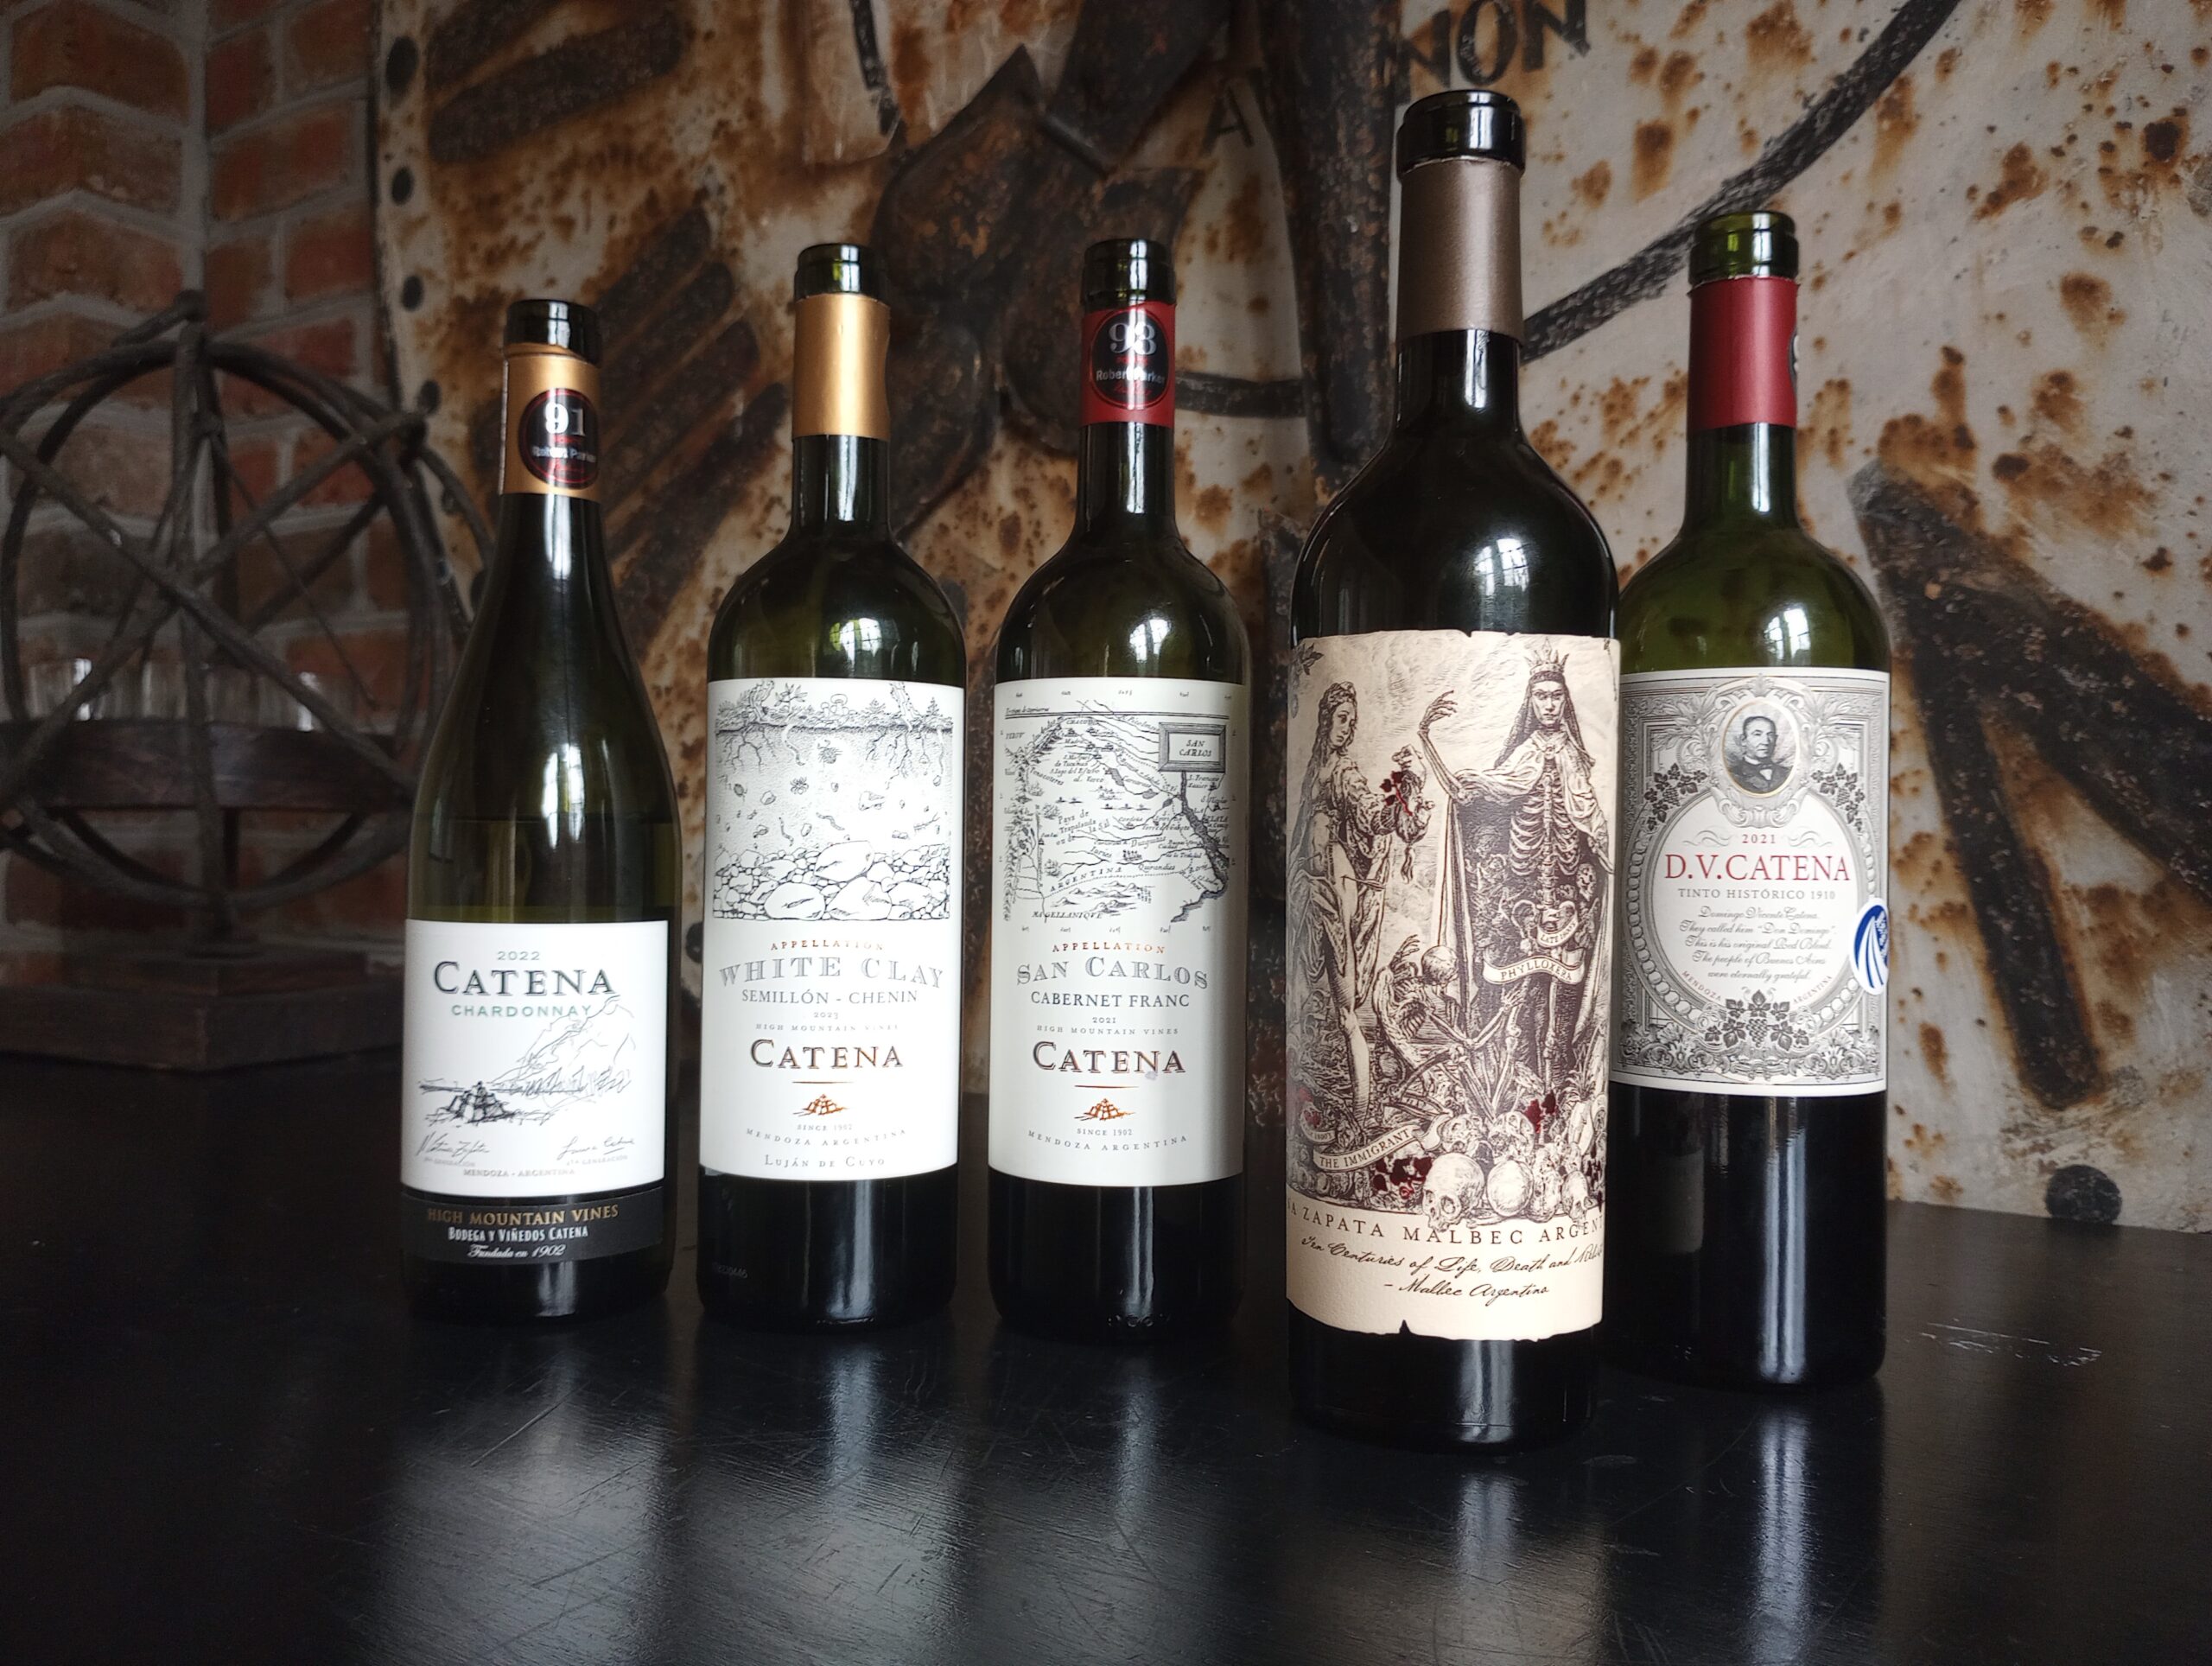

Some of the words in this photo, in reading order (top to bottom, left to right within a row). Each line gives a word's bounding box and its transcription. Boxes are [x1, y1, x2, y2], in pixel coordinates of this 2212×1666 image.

[1096, 366, 1132, 381] Rober
[544, 400, 586, 436] 91
[1741, 833, 1777, 844] 2021
[1678, 888, 1720, 899] TINTO
[1726, 887, 1805, 900] HISTÓRICO
[1811, 891, 1836, 900] 1910
[1707, 922, 1732, 933] called
[1735, 923, 1754, 933] him
[770, 939, 884, 951] APPELLATION
[1052, 941, 1166, 954] APPELLATION
[1685, 934, 1707, 948] This
[1718, 938, 1731, 948] his
[1732, 938, 1771, 952] original
[497, 951, 540, 961] 2022
[1692, 950, 1713, 963] The
[1711, 953, 1742, 966] people
[1744, 953, 1756, 967] of
[1755, 951, 1794, 965] Buenos
[434, 961, 616, 996] CATENA
[719, 957, 842, 988] WHITE
[861, 957, 944, 989] CLAY
[1016, 960, 1070, 986] SAN
[1084, 956, 1209, 989] CARLOS
[1501, 959, 1573, 981] PHYLLOXERA
[1681, 970, 1722, 1002] MENDOZA
[1793, 975, 1833, 1004] ARGENTINA
[741, 989, 830, 1004] SEMILLÓN
[849, 990, 918, 1004] CHENIN
[1031, 991, 1122, 1008] CABERNET
[1128, 994, 1190, 1008] FRANC
[451, 1004, 592, 1018] CHARDONNAY
[813, 1011, 839, 1020] 2023
[1037, 1025, 1064, 1033] HIGH
[750, 1039, 903, 1070] CATENA
[1033, 1040, 1186, 1074] CATENA
[746, 1128, 811, 1146] MENDOZA
[822, 1129, 906, 1146] ARGENTINA
[1027, 1129, 1091, 1150] MENDOZA
[1102, 1135, 1188, 1151] ARGENTINA
[1077, 1128, 1108, 1136] SINCE
[1319, 1156, 1340, 1169] THE
[1344, 1128, 1411, 1167] IMMIGRANT
[463, 1168, 510, 1177] MENDOZA
[427, 1209, 464, 1223] HIGH
[469, 1211, 565, 1226] MOUNTAIN
[571, 1205, 620, 1223] VINES
[448, 1226, 486, 1242] BODEGA
[488, 1229, 495, 1242] Y
[498, 1226, 545, 1243] VIÑEDOS
[548, 1225, 589, 1240] CATENA
[1302, 1206, 1384, 1237] ZAPATA
[1403, 1226, 1524, 1245] MALBEC
[467, 1243, 514, 1259] Fundada
[515, 1250, 529, 1258] en
[531, 1243, 568, 1257] 1902
[1301, 1236, 1325, 1251] Ten
[1328, 1242, 1404, 1267] Centuries
[1409, 1256, 1433, 1275] of
[1433, 1256, 1482, 1279] Life,
[1490, 1257, 1547, 1273] Death
[1548, 1246, 1579, 1269] and
[1398, 1273, 1464, 1297] Malbec
